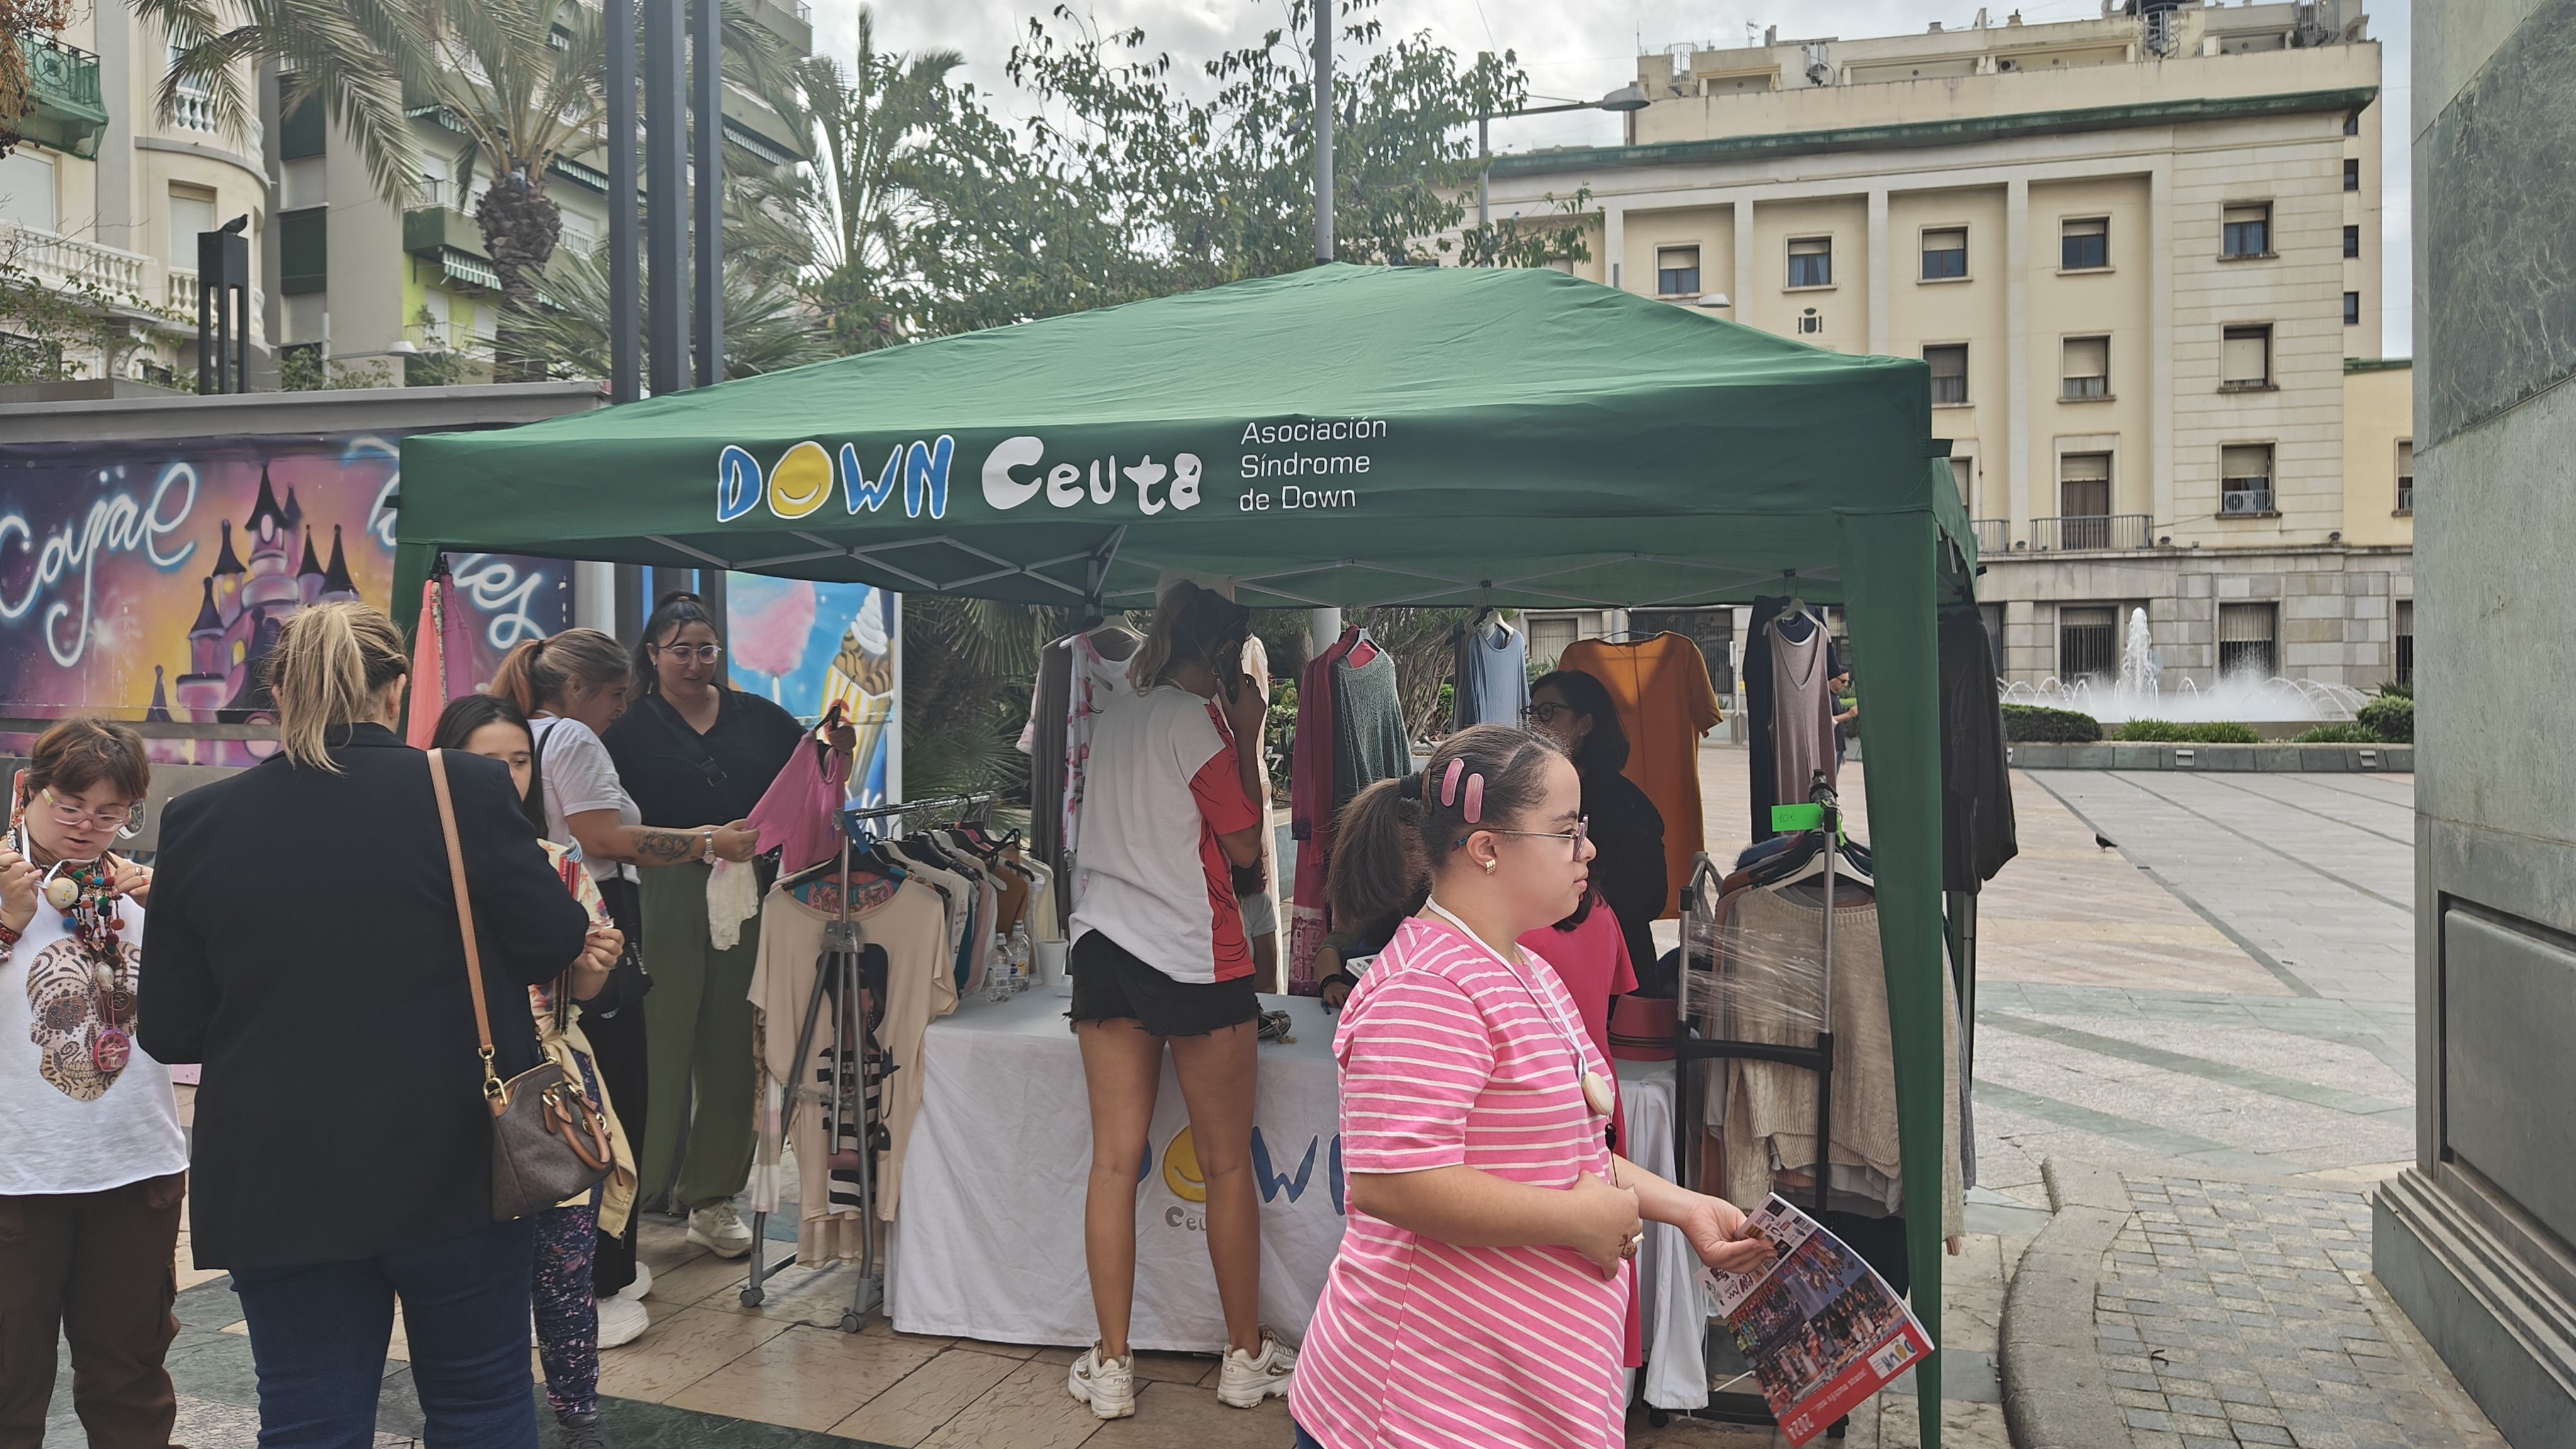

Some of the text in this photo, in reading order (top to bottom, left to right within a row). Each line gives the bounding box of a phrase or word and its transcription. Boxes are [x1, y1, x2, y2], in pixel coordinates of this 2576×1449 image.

[1240, 416, 1387, 445] Asociación
[717, 434, 1202, 523] DOWN Ceuta
[1240, 452, 1370, 479] Síndrome
[1240, 485, 1357, 512] de Down
